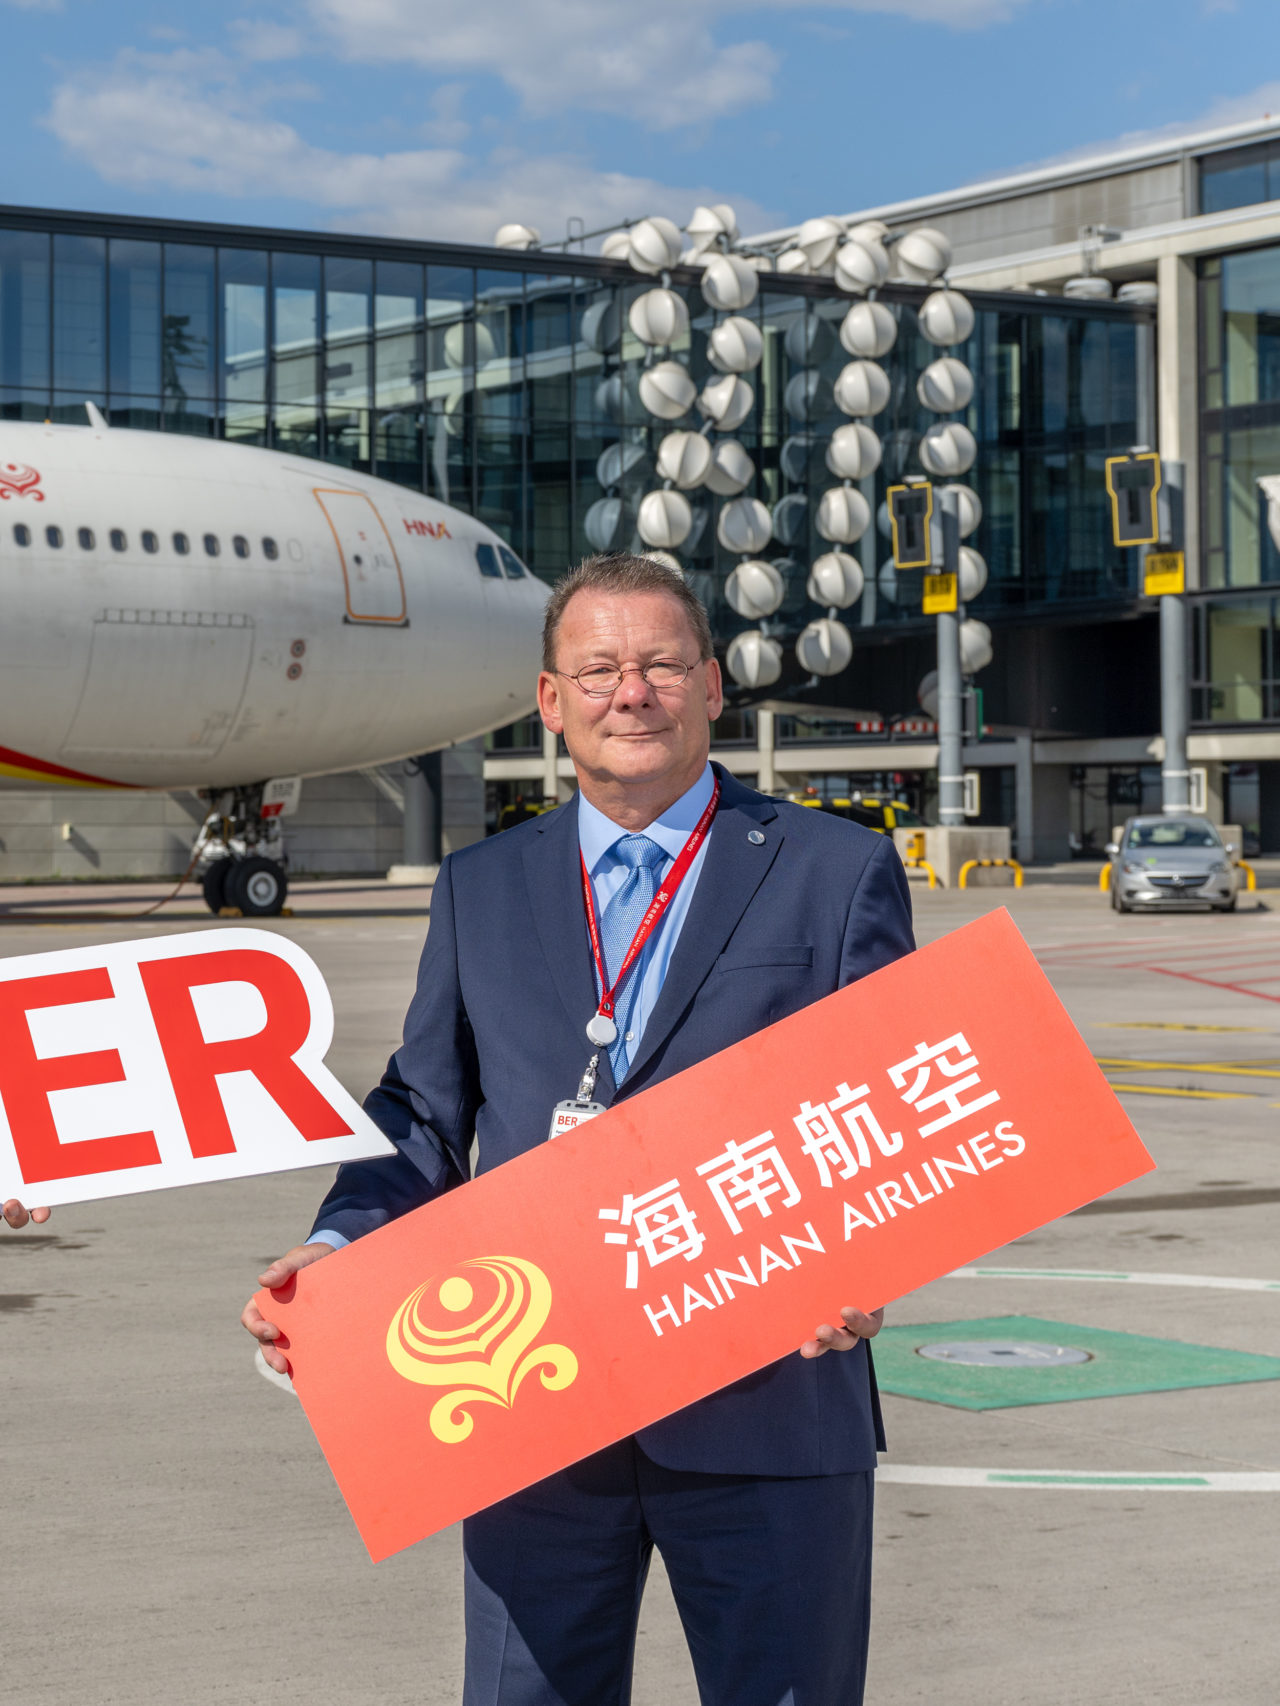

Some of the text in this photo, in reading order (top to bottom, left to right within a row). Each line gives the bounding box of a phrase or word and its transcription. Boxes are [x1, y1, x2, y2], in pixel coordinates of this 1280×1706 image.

[402, 518, 452, 540] HNA
[557, 1115, 578, 1127] BER
[598, 1031, 1001, 1289] 海南航空
[643, 1120, 1026, 1337] HAINAN AIRLINES
